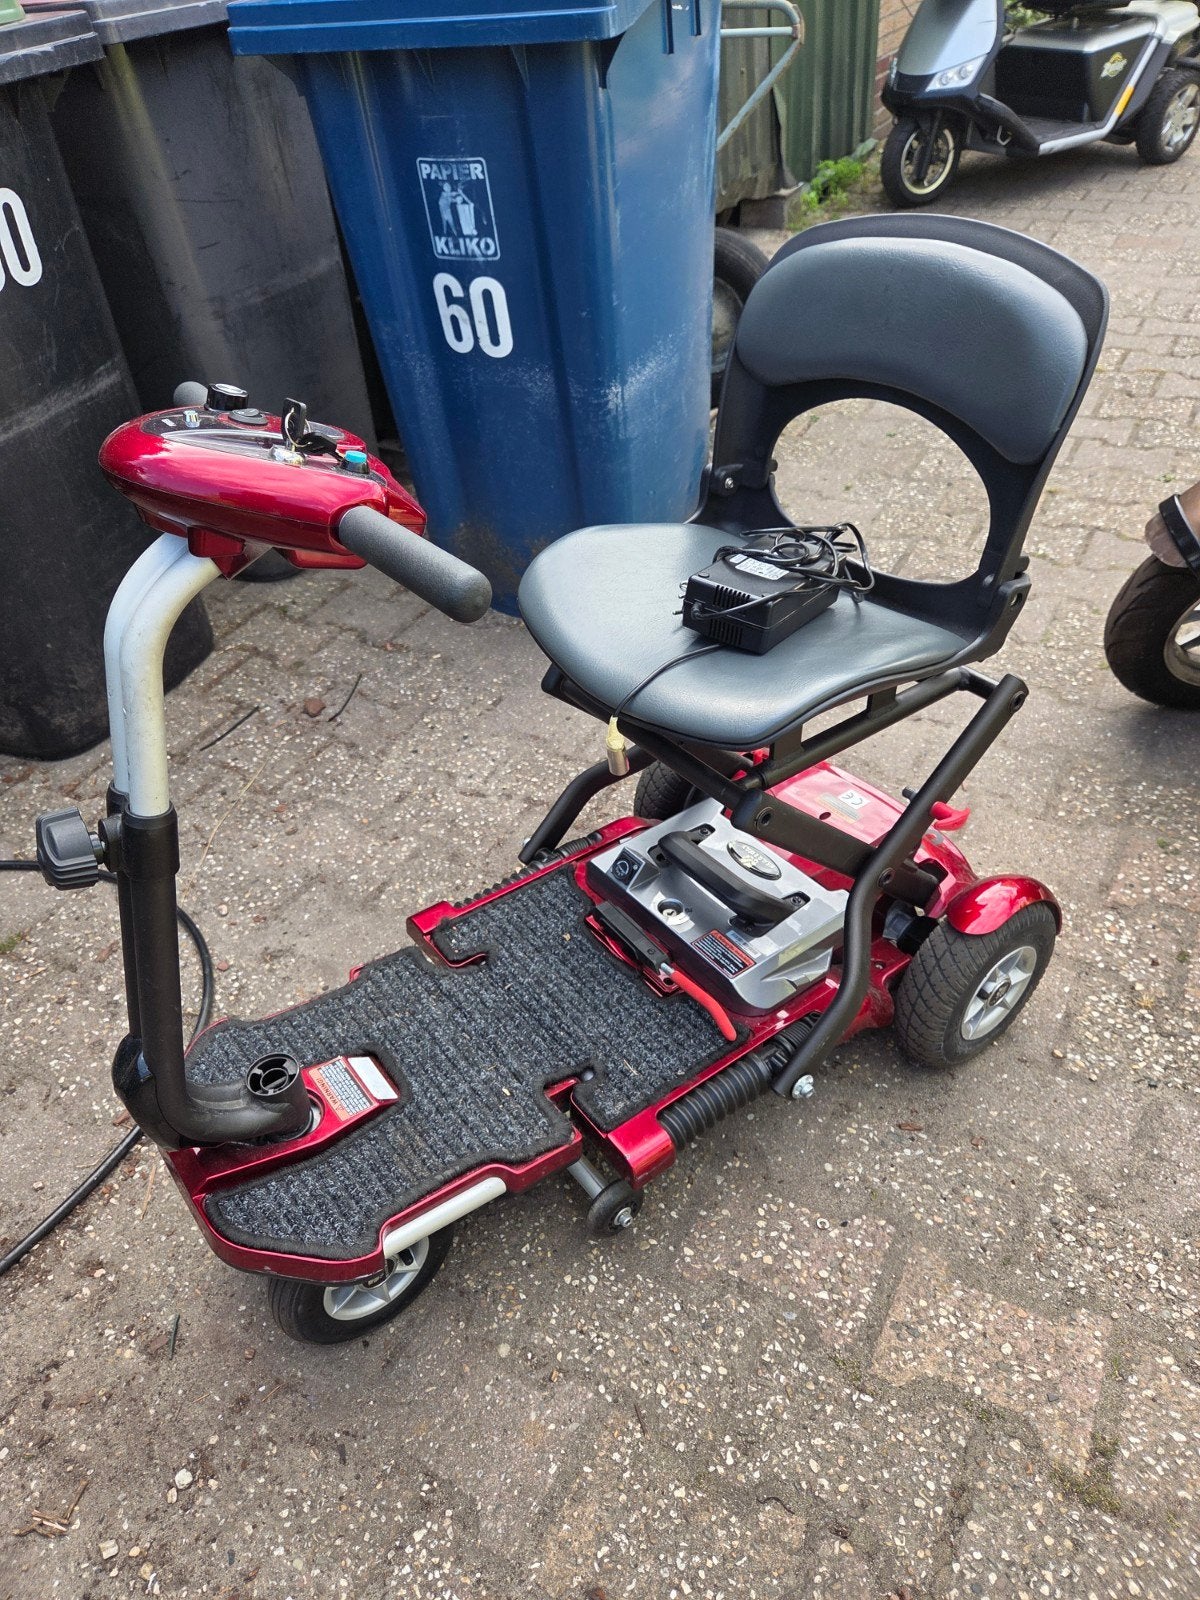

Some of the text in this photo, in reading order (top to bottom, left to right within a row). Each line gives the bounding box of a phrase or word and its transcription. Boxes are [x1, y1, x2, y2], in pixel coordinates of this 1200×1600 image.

[419, 162, 484, 181] PAPIER
[0, 187, 43, 292] 0
[434, 235, 497, 256] KLIKO
[432, 272, 514, 359] 60
